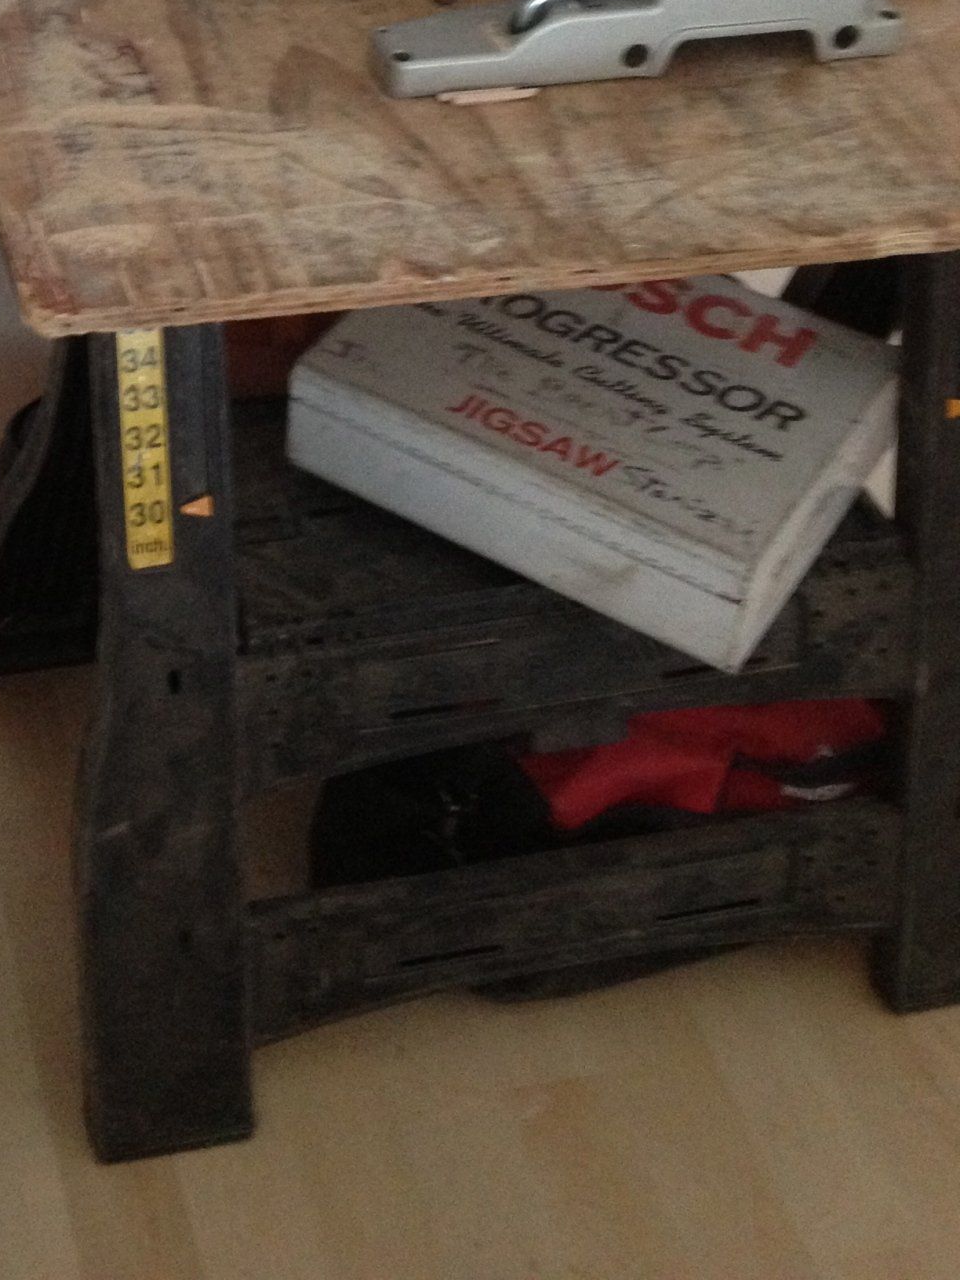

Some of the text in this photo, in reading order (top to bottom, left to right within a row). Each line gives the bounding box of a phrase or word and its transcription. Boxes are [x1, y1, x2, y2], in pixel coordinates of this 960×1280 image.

[590, 278, 819, 369] SCH
[119, 346, 158, 374] 34
[480, 295, 807, 431] OGRESSOR
[123, 384, 160, 412] 33
[572, 365, 670, 416] Cutting
[679, 412, 783, 463] System
[125, 422, 163, 451] 32
[445, 395, 621, 477] JIGSAW
[127, 463, 162, 489] 31
[130, 500, 165, 528] 30
